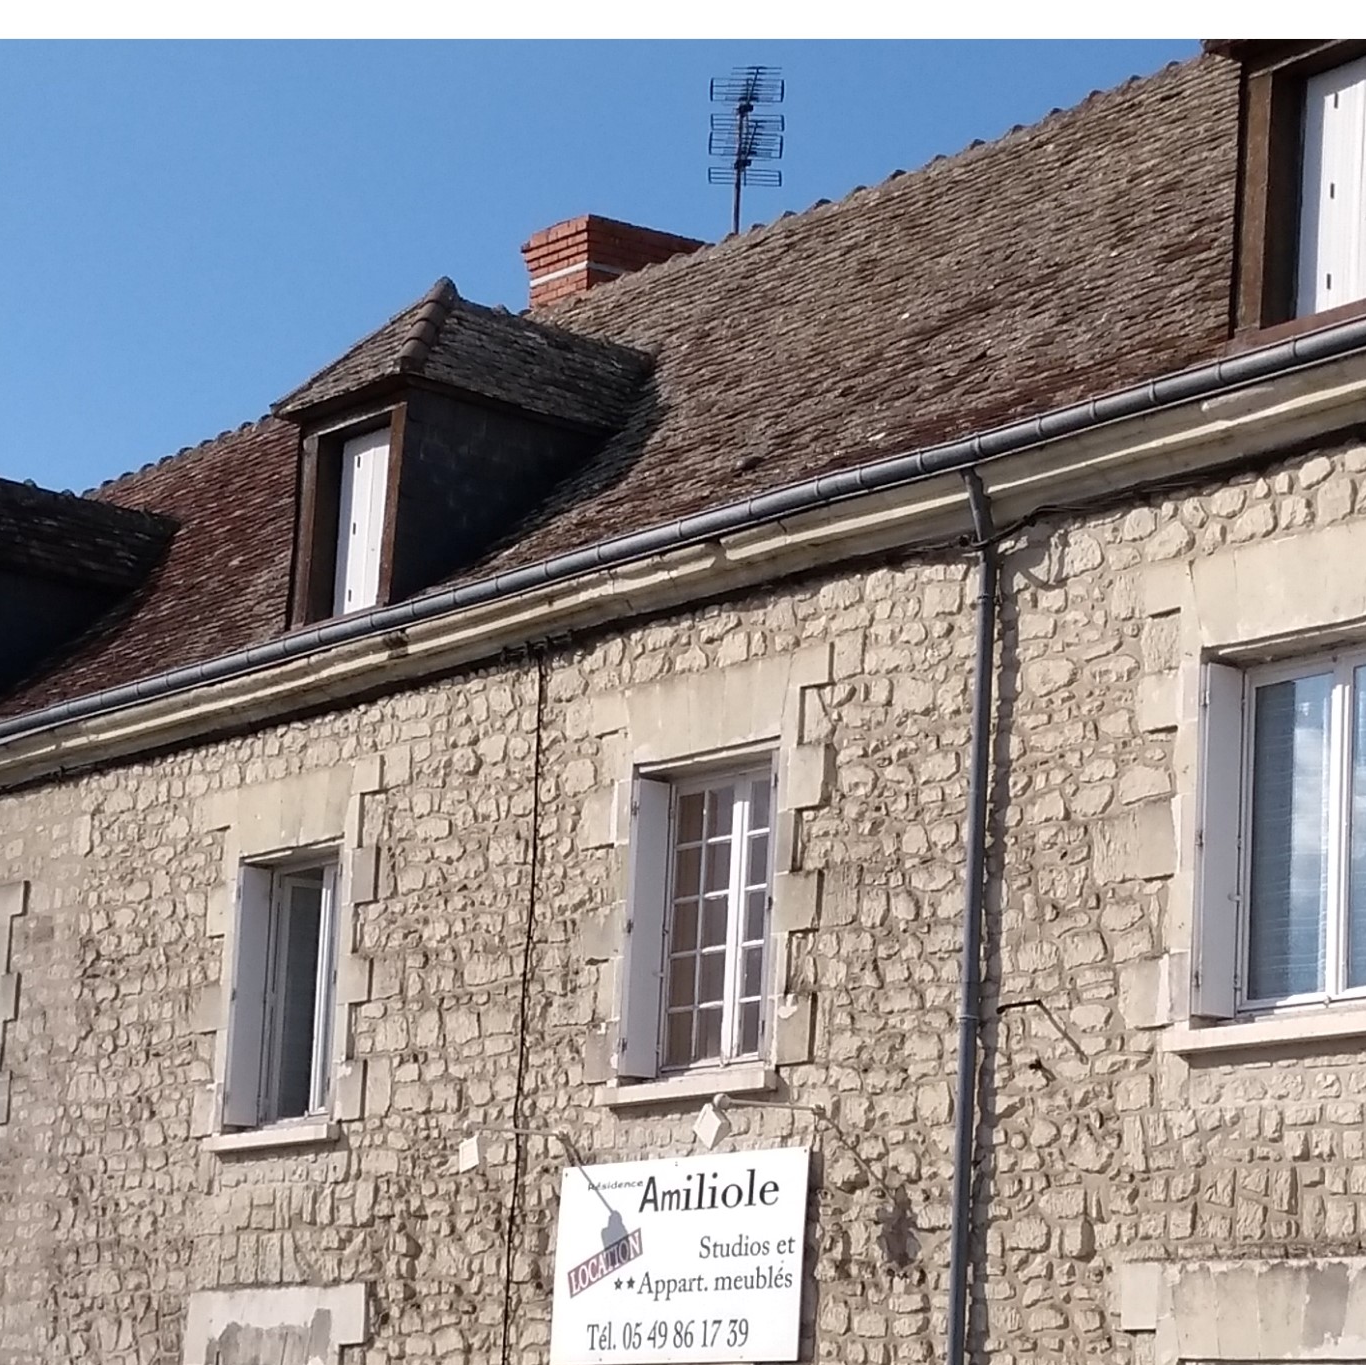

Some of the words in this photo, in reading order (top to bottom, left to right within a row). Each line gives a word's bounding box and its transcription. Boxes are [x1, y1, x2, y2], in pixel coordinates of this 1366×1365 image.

[638, 1168, 780, 1213] Amiliole
[569, 1231, 641, 1296] LOCATION
[698, 1233, 770, 1259] Studios
[776, 1236, 796, 1255] et
[637, 1271, 708, 1301] Appart.
[713, 1265, 793, 1291] meublés
[586, 1321, 617, 1351] Tél.
[622, 1321, 642, 1350] 05
[647, 1319, 668, 1349] 49
[673, 1319, 695, 1349] 86
[701, 1319, 723, 1348] 17
[727, 1318, 749, 1347] 39
